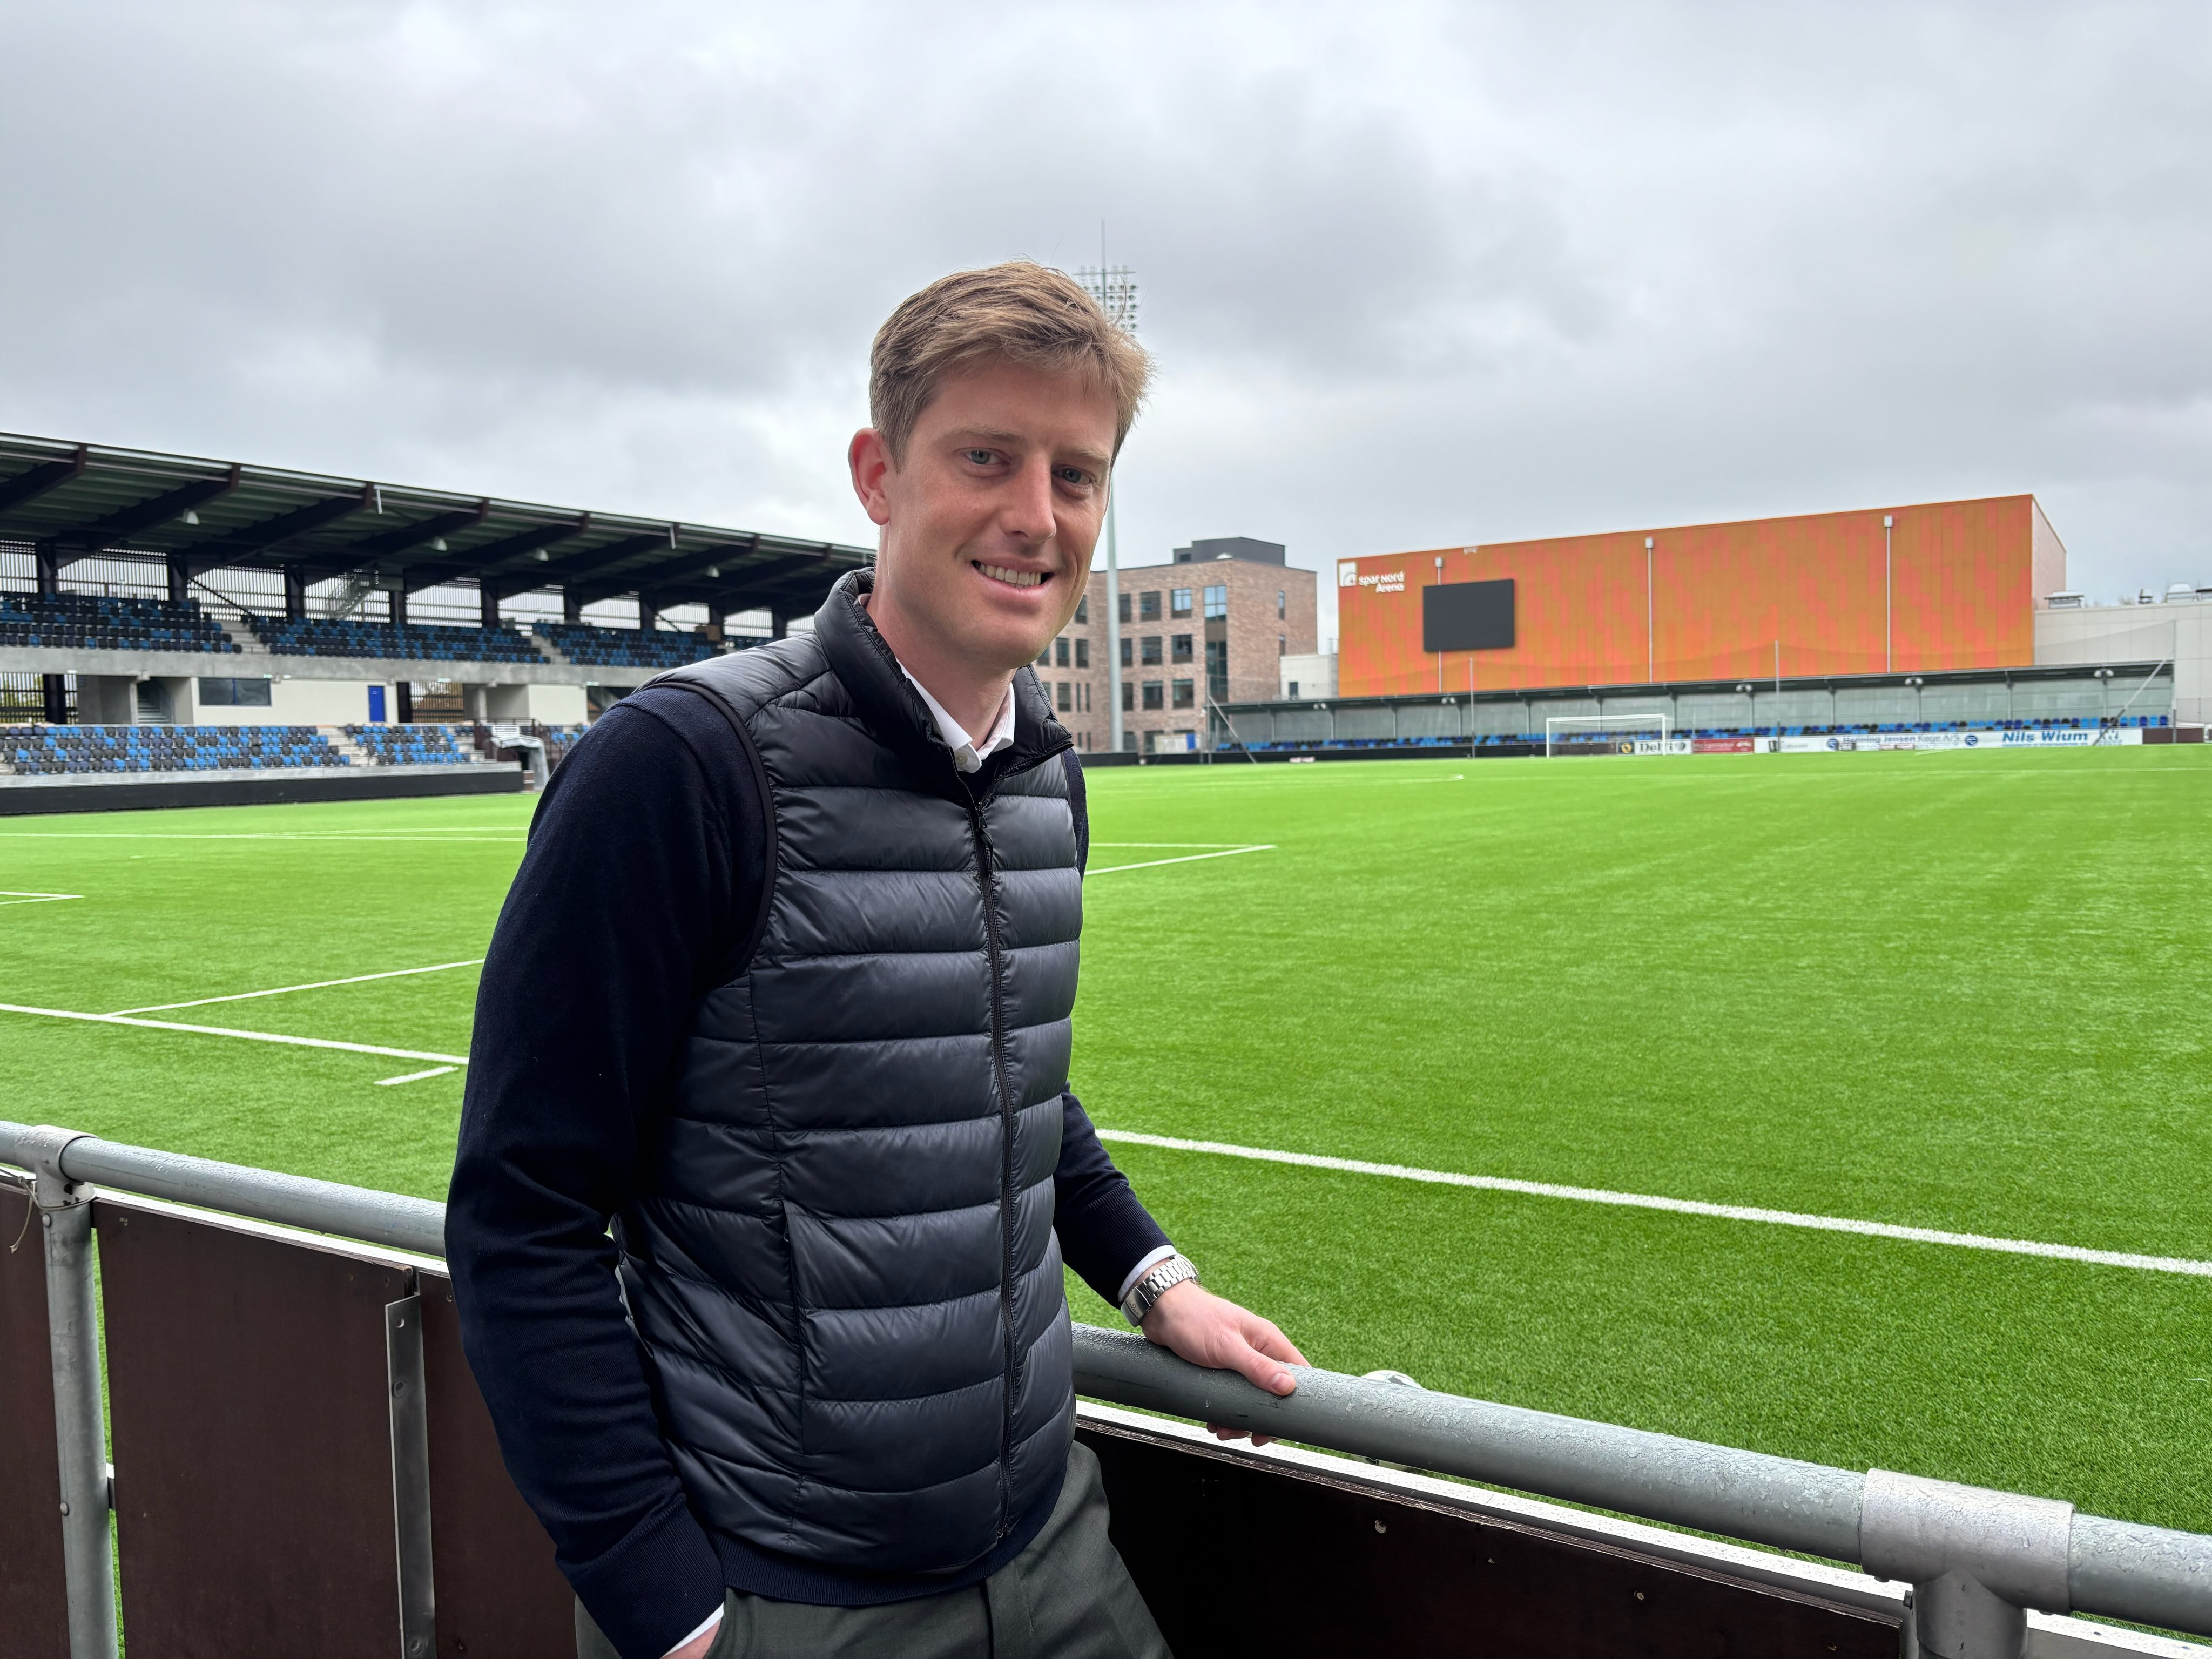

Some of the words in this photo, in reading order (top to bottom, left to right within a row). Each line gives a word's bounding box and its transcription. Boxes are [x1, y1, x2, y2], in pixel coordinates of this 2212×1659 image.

[1375, 583, 1405, 593] Arena
[2002, 731, 2034, 742] Nils
[2041, 730, 2088, 741] Wium
